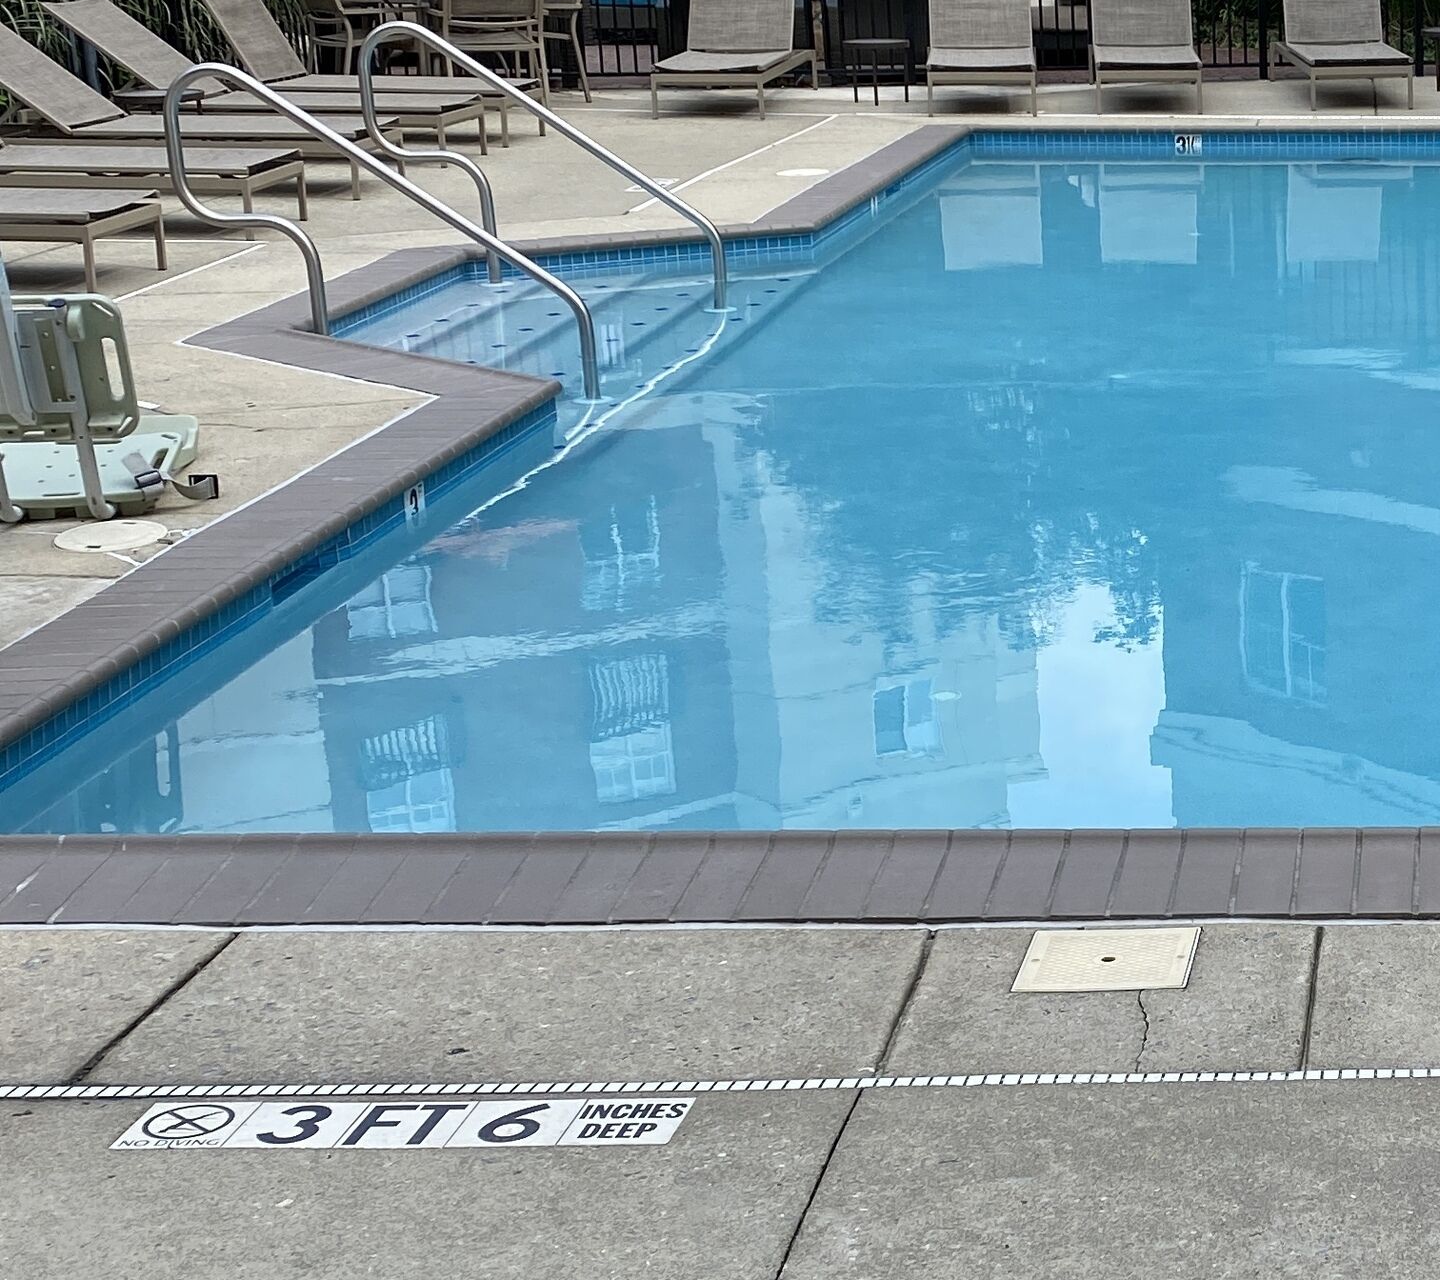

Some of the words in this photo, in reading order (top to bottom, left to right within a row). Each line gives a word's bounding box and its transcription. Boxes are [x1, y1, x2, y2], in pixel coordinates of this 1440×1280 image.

[256, 1105, 333, 1144] 3
[342, 1104, 469, 1146] FT
[478, 1103, 552, 1142] 6
[579, 1103, 688, 1120] INCHES
[577, 1122, 658, 1140] DEEP
[118, 1139, 152, 1148] NO
[152, 1138, 220, 1148] DIVING
